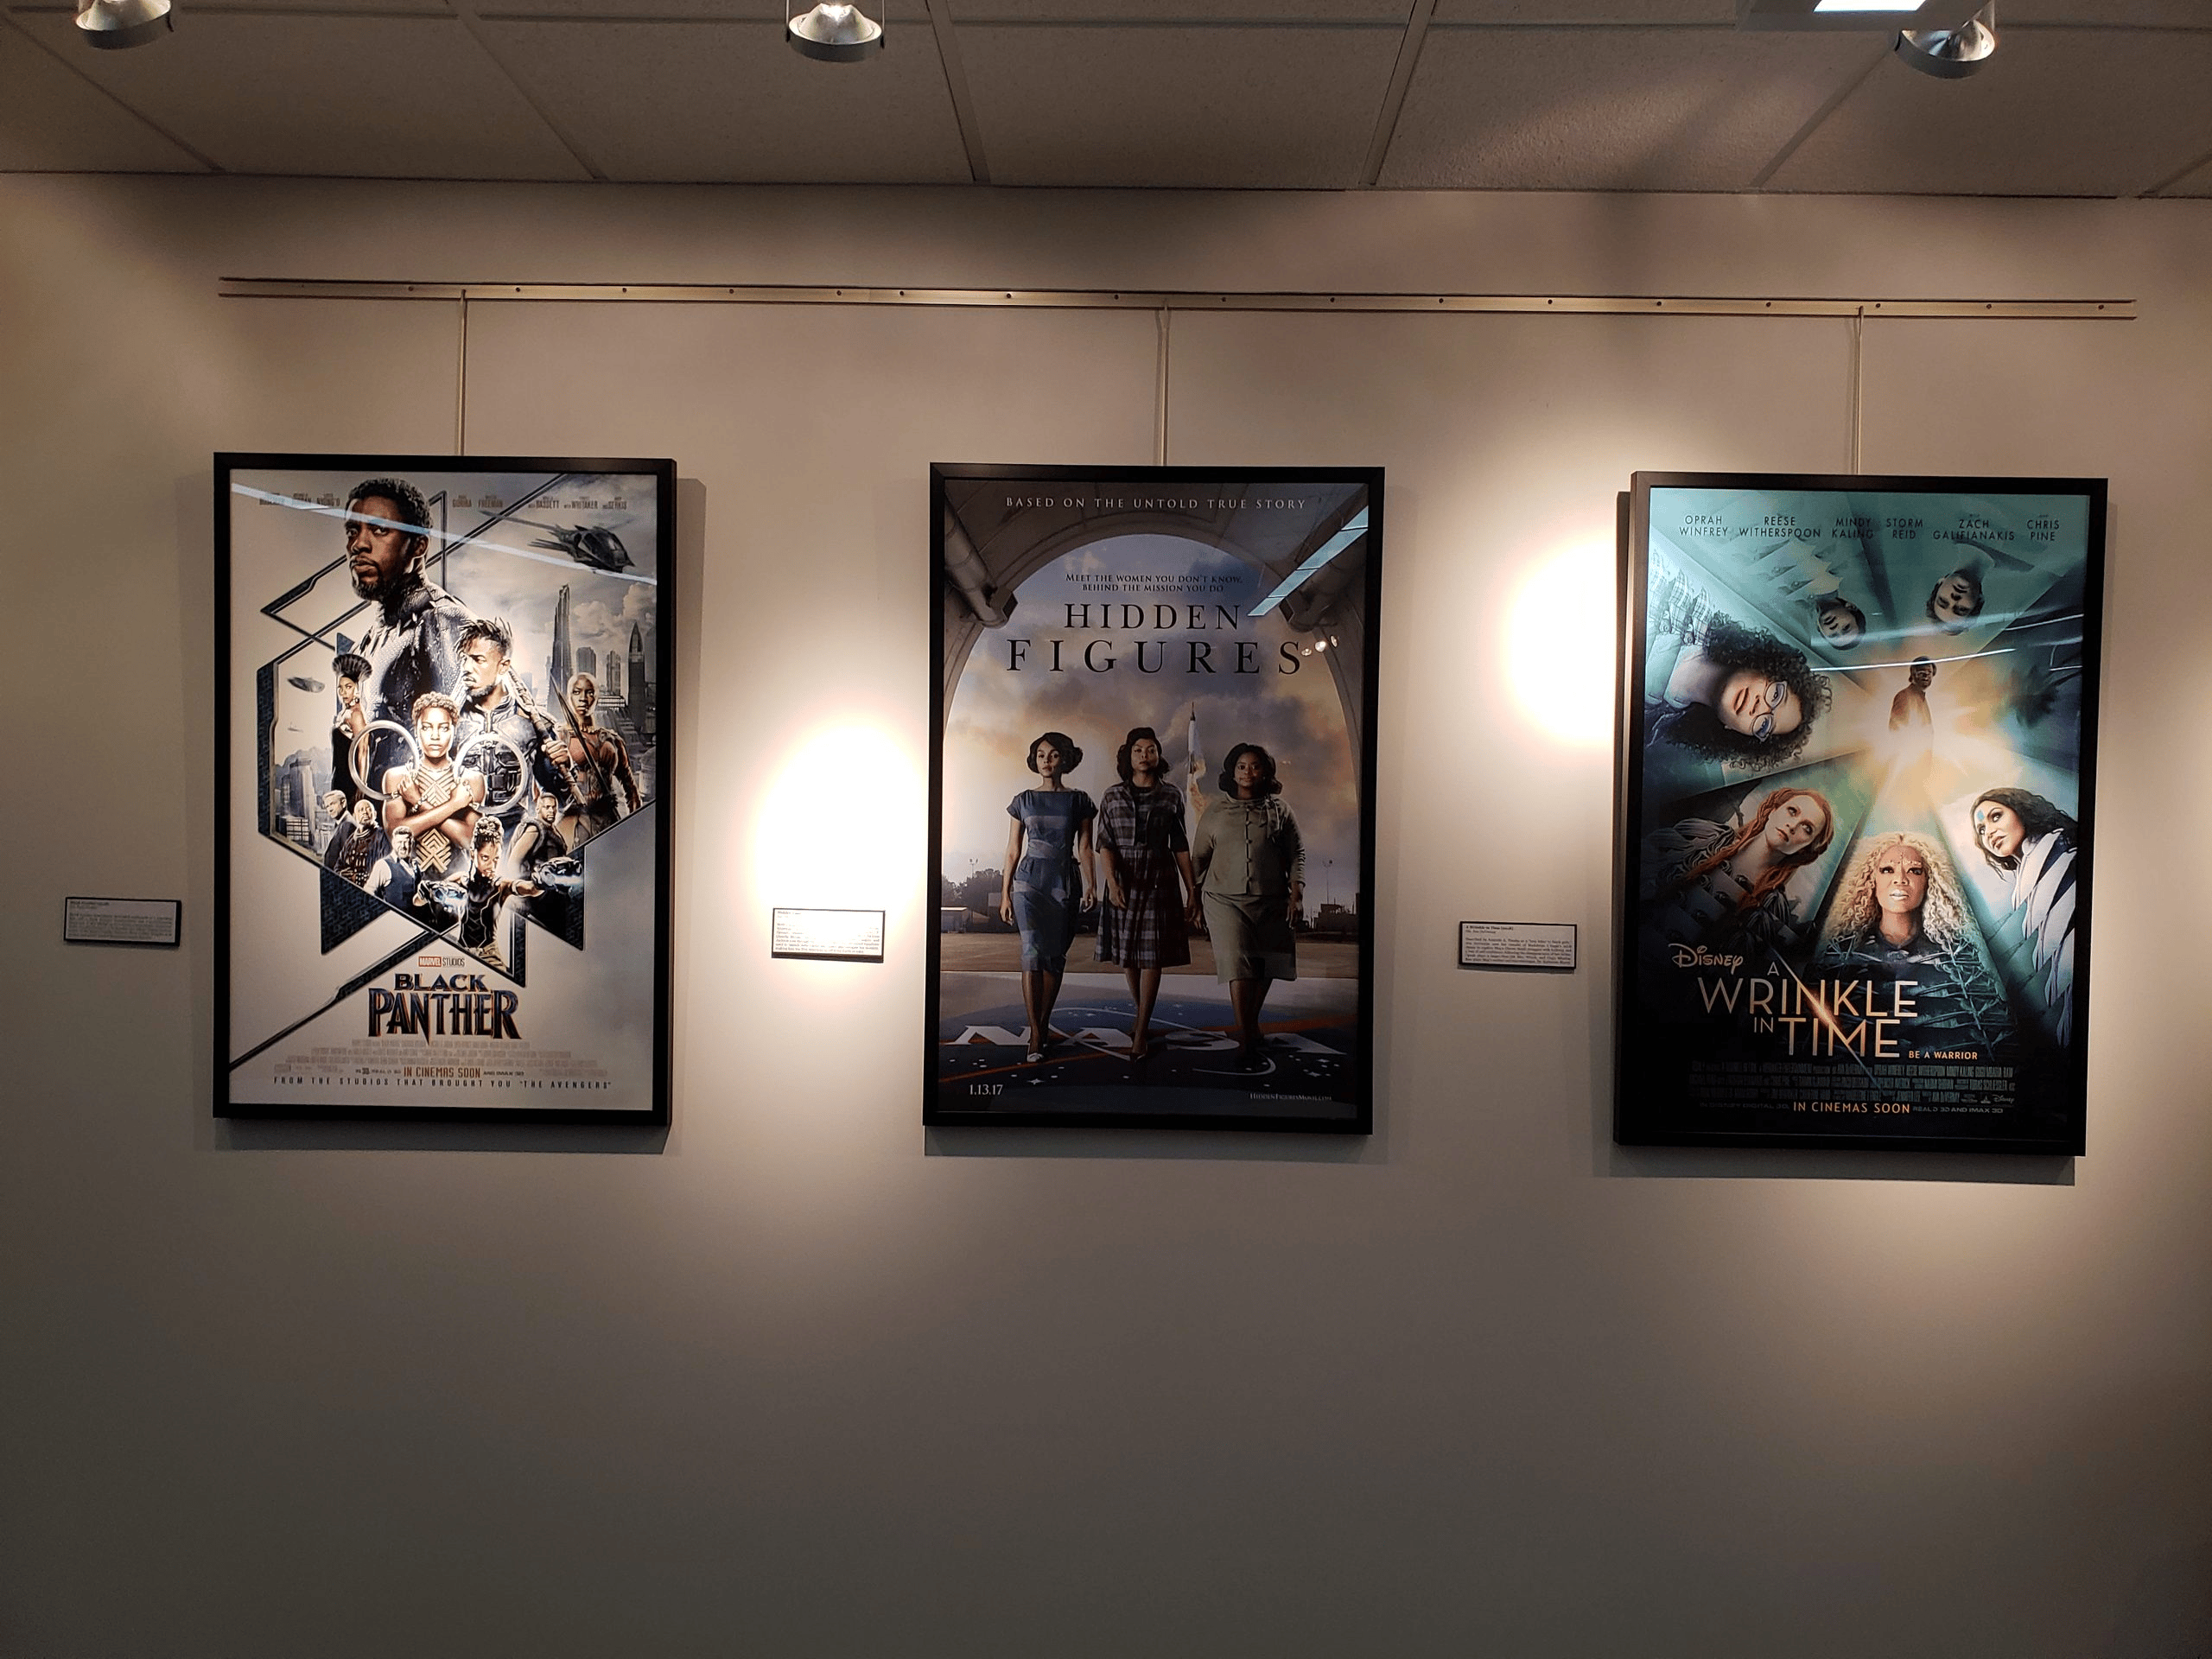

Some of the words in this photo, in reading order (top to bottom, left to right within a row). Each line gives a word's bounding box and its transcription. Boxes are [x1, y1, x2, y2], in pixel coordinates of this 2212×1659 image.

[1006, 497, 1054, 508] BASED
[1063, 498, 1084, 508] ON
[1094, 498, 1124, 509] THE
[1134, 499, 1198, 510] UNTOLD
[1207, 499, 1246, 510] TRUE
[1255, 499, 1306, 510] STORY
[1684, 515, 1723, 525] OPRAH
[1764, 516, 1796, 526] REESE
[1835, 518, 1872, 528] MINDY
[1885, 518, 1923, 529] STORM
[1959, 519, 1990, 530] ZACH
[2026, 520, 2061, 531] CHRIS
[1679, 526, 1729, 537] WINFREY
[1738, 528, 1821, 539] WITHERSPOON
[1832, 529, 1875, 540] KALING
[1892, 530, 1916, 540] REID
[1933, 531, 2016, 542] GALIFIANAKIS
[2031, 532, 2056, 542] PINE
[1065, 573, 1092, 582] MEET
[1095, 574, 1113, 582] THE
[1116, 574, 1153, 583] WOMEN
[1154, 575, 1175, 583] YOU
[1177, 575, 1208, 584] DON'T
[1082, 583, 1120, 593] BEHIND
[1122, 583, 1141, 593] THE
[1143, 584, 1184, 594] MISSION
[1185, 584, 1207, 594] YOU
[1064, 603, 1240, 630] HIDDEN
[1006, 639, 1300, 675] FIGURES
[419, 957, 442, 967] MARVEL
[442, 957, 465, 967] STUDIOS
[1668, 943, 1744, 976] Disney
[1766, 961, 1780, 976] A
[394, 973, 486, 992] BLACK
[1697, 976, 1918, 1018] WRINKLE
[368, 988, 522, 1046] PANTHER
[1753, 1016, 1774, 1033] IN
[1777, 1016, 1901, 1058] TIME
[1908, 1051, 1921, 1059] BE
[1923, 1051, 1931, 1059] A
[1934, 1051, 1979, 1061] WARRIOR
[404, 1066, 412, 1077] IN
[416, 1066, 454, 1077] CINEMAS
[458, 1067, 481, 1078] SOON
[311, 1077, 330, 1085] THE
[340, 1077, 389, 1086] STUDIOS
[431, 1079, 483, 1088] BROUGHT
[969, 1084, 1003, 1096] 1.13.17
[1793, 1102, 1806, 1112] IN
[1811, 1102, 1868, 1113] CINEMAS
[1873, 1103, 1910, 1114] SOON
